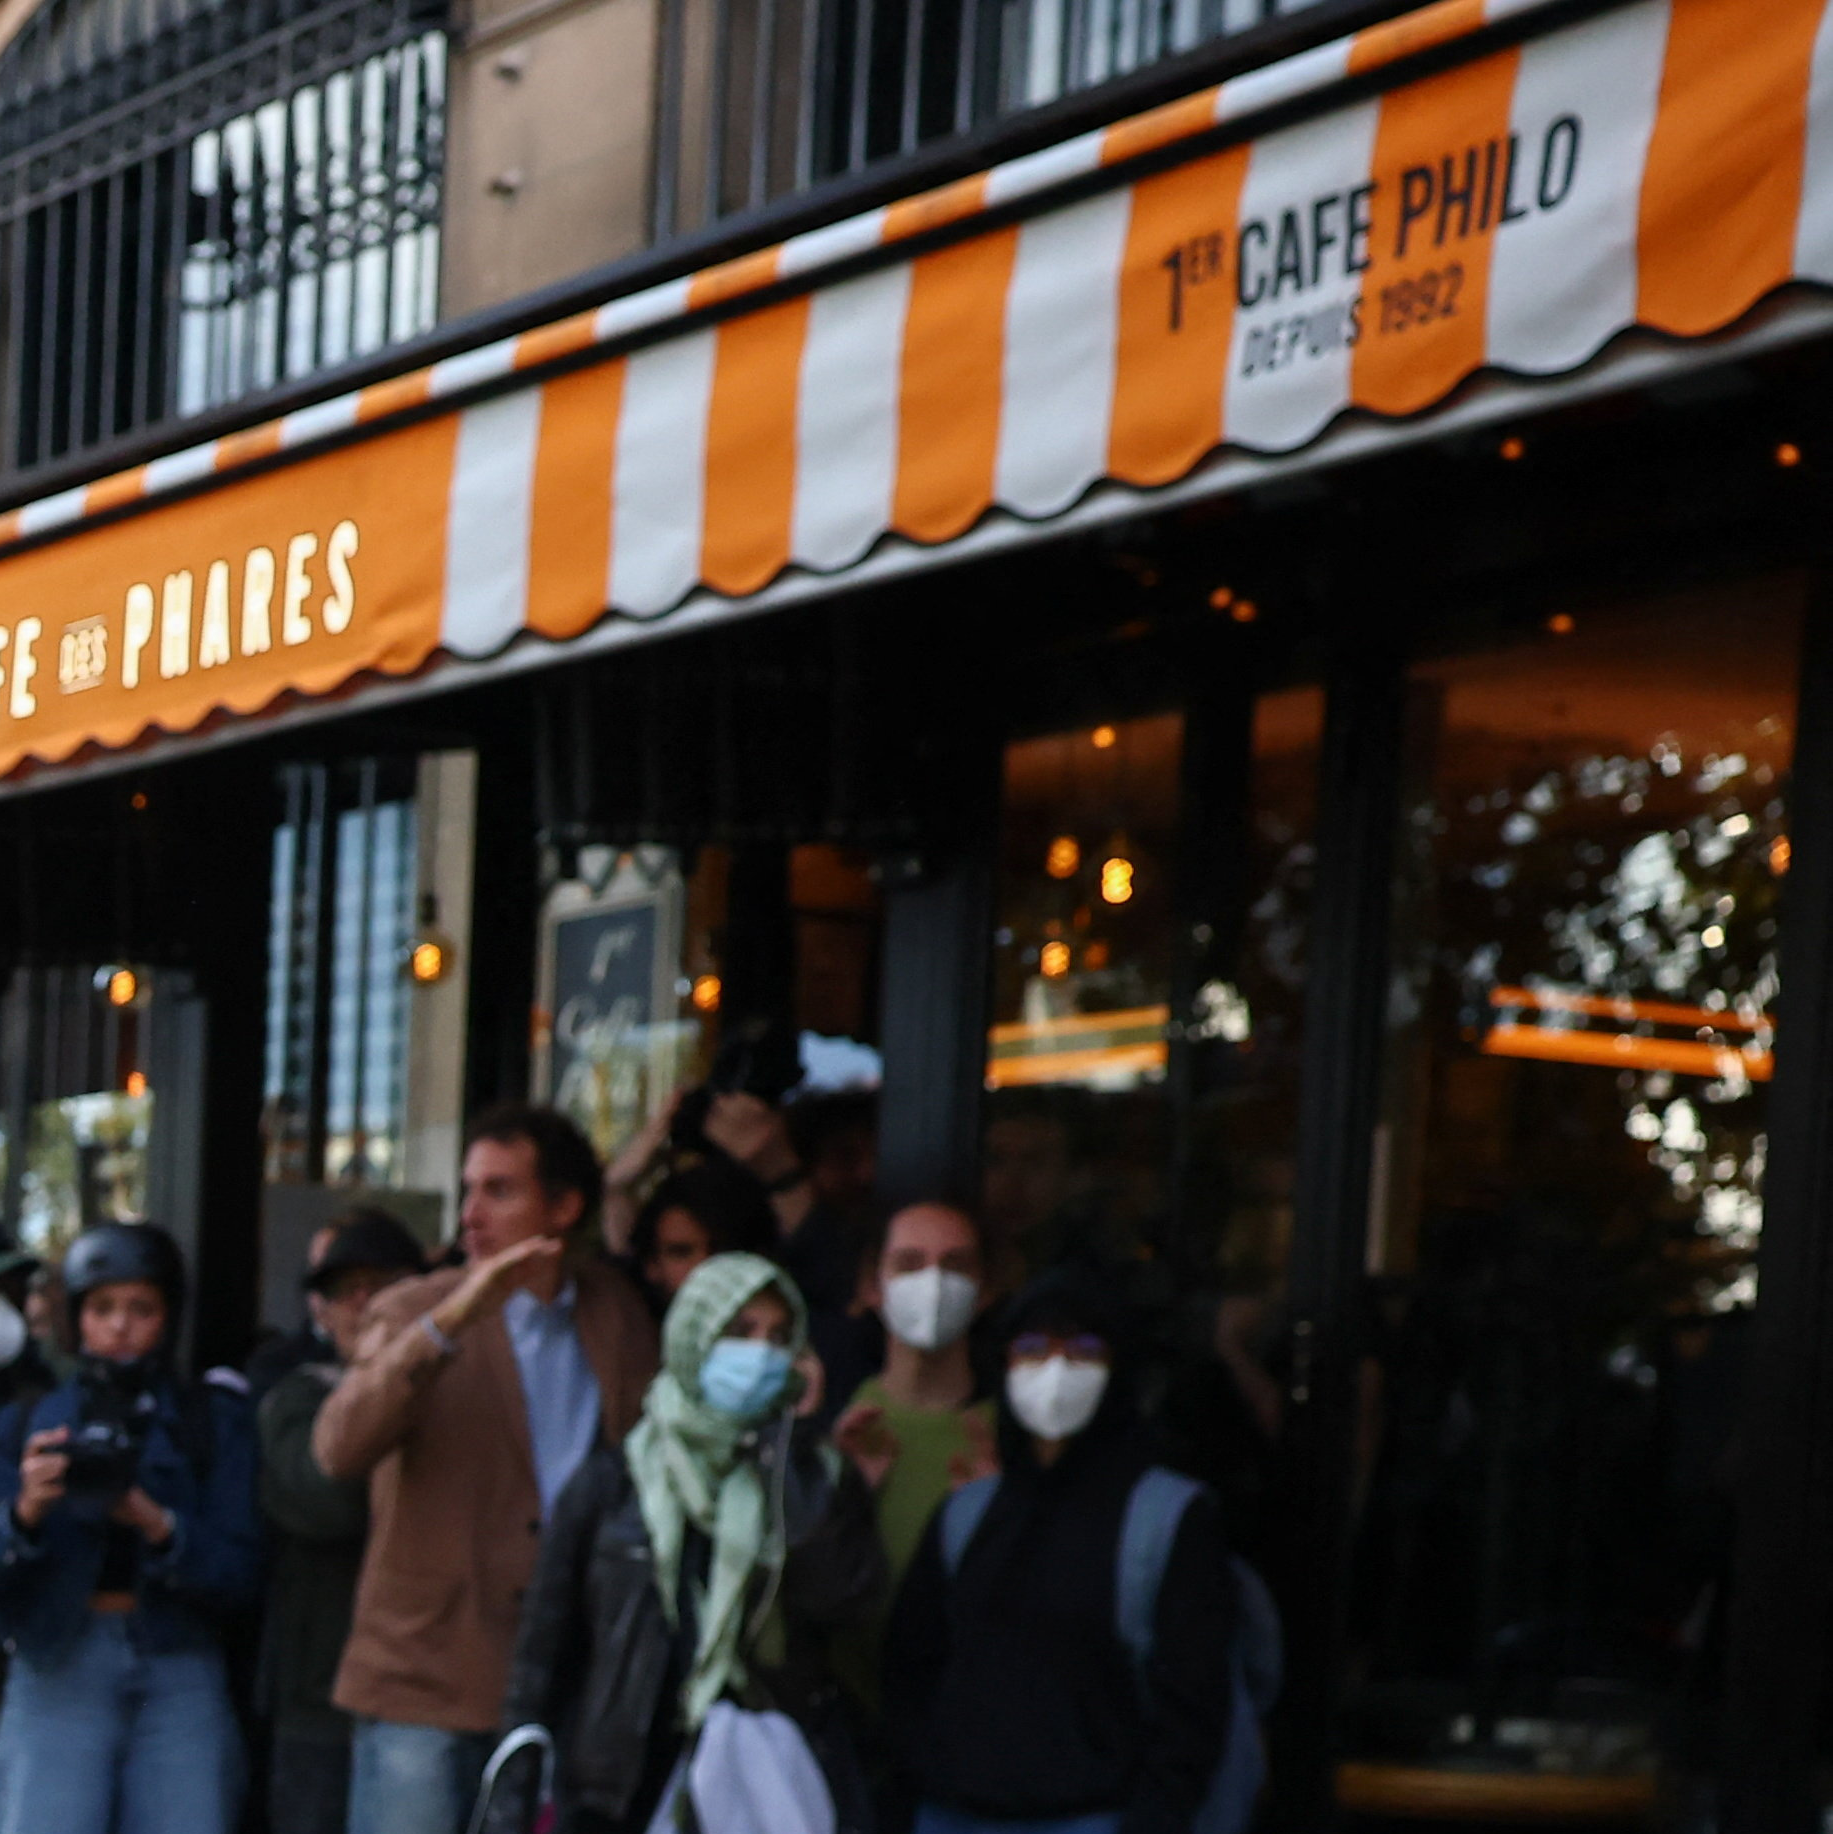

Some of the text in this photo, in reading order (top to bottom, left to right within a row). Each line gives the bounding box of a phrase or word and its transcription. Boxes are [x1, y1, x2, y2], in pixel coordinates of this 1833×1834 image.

[1162, 114, 1583, 335] 1ER CAFE PHILO
[1240, 261, 1465, 379] DEPUIS 1992
[120, 518, 361, 691] PHARES
